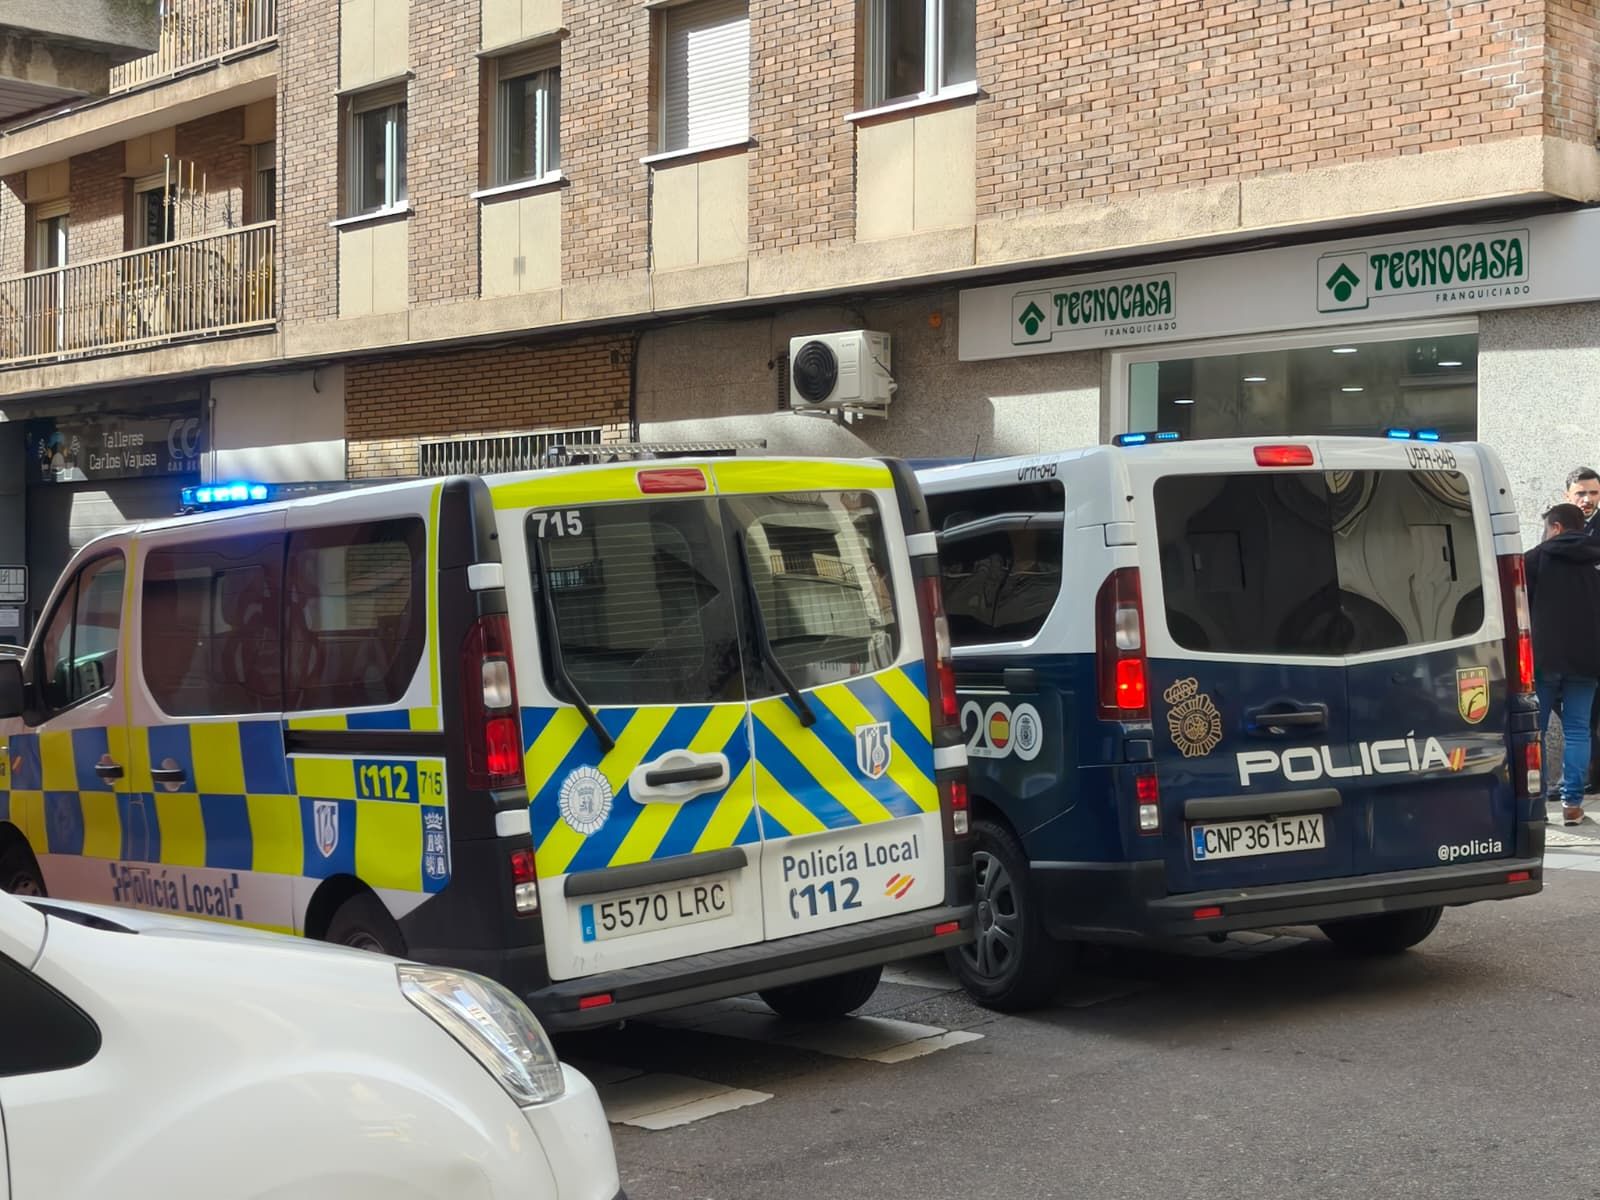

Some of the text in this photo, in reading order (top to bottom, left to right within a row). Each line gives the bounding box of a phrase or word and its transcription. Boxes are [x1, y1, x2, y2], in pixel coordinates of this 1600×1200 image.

[1369, 238, 1523, 292] TECNOCASA
[1053, 280, 1172, 326] TECNOCASA
[1435, 285, 1530, 303] FRANQUICIADO
[1104, 321, 1177, 337] FRANQUICIADO
[102, 432, 144, 449] Talleres
[89, 453, 121, 470] Carlos
[1404, 447, 1457, 469] UPR-84B
[531, 510, 583, 538] 715
[1236, 729, 1452, 786] POLICÍA
[419, 770, 443, 796] 715
[782, 833, 920, 882] Policía Local
[1437, 838, 1503, 862] @policia
[120, 865, 232, 918] Policía Local
[600, 894, 669, 931] 5570
[677, 884, 726, 918] LRC
